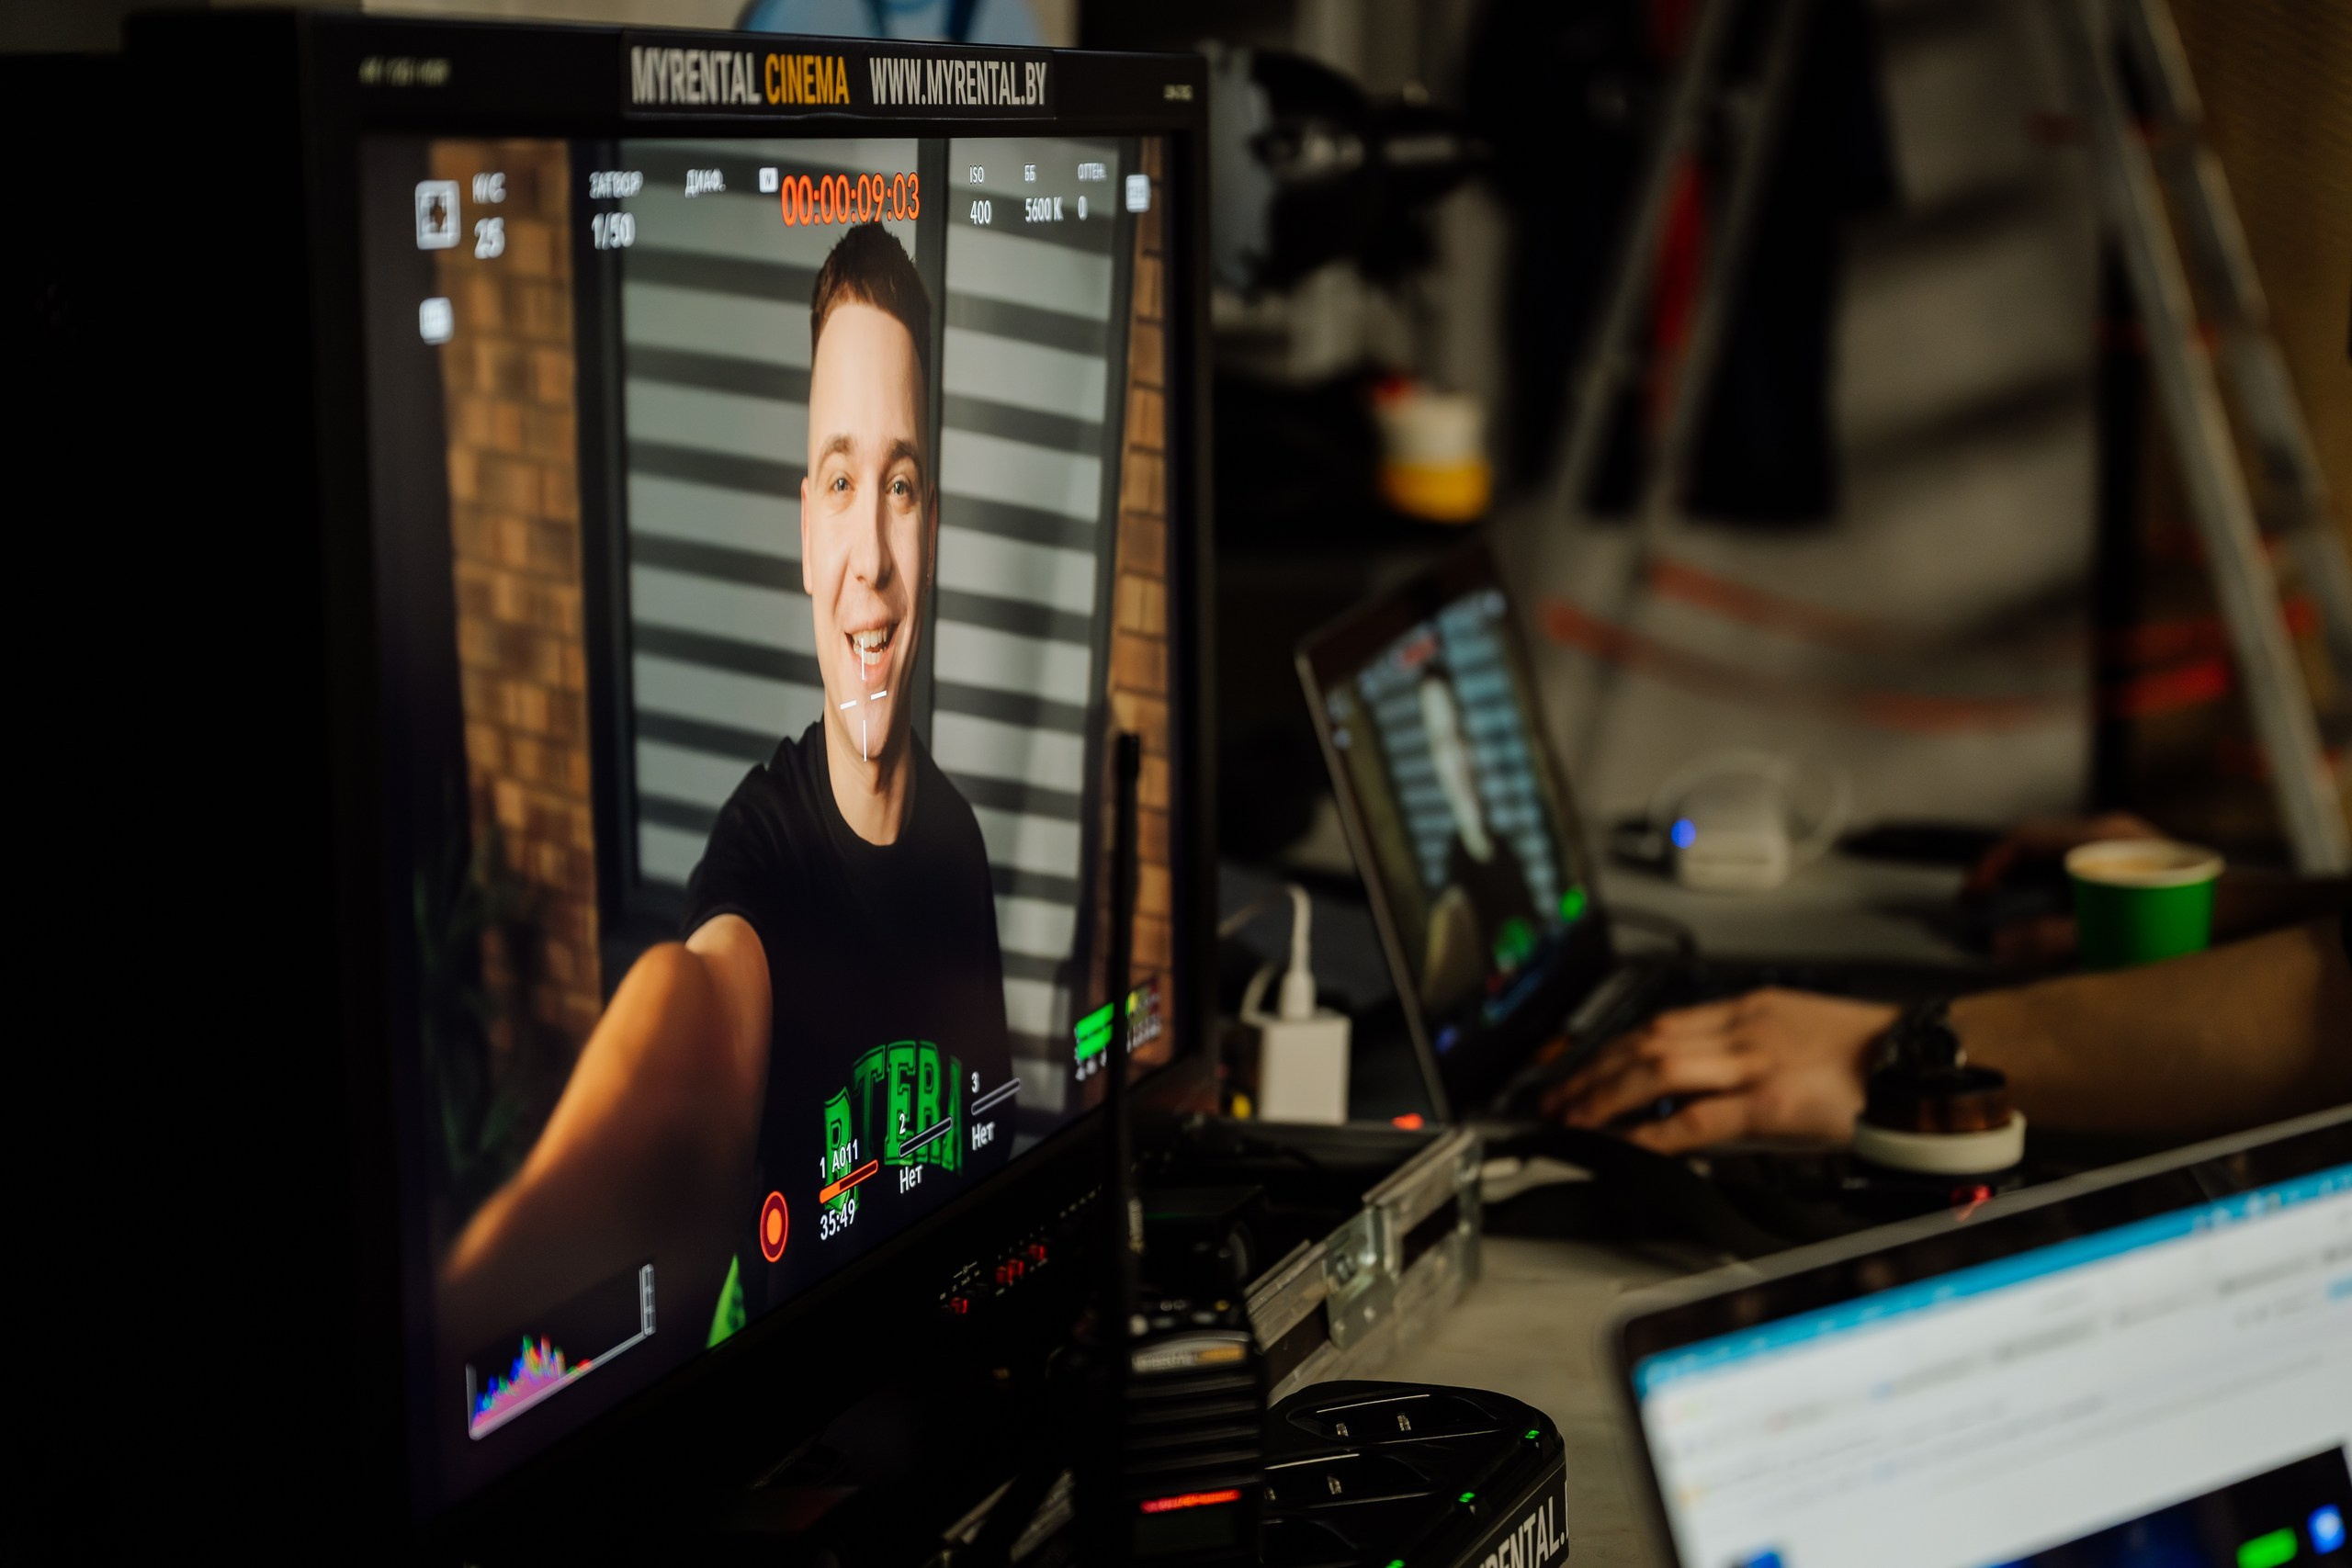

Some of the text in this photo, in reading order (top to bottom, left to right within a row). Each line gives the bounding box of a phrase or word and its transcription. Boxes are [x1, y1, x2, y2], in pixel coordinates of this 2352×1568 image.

[630, 46, 1046, 106] MYRENTAL CINEMA WWW.MYRENTAL.BY
[969, 164, 985, 185] ISO
[780, 171, 920, 228] 00:00:09:03
[970, 199, 993, 225] 400
[1024, 196, 1052, 223] 5600
[1077, 195, 1089, 220] 0
[474, 216, 505, 260] 25
[591, 211, 636, 250] 1/50
[971, 1071, 980, 1093] 3
[899, 1112, 907, 1134] 2
[971, 1121, 996, 1151] Нет
[820, 1138, 859, 1179] 1 A011
[899, 1164, 923, 1194] Нет
[820, 1198, 856, 1241] 35:49
